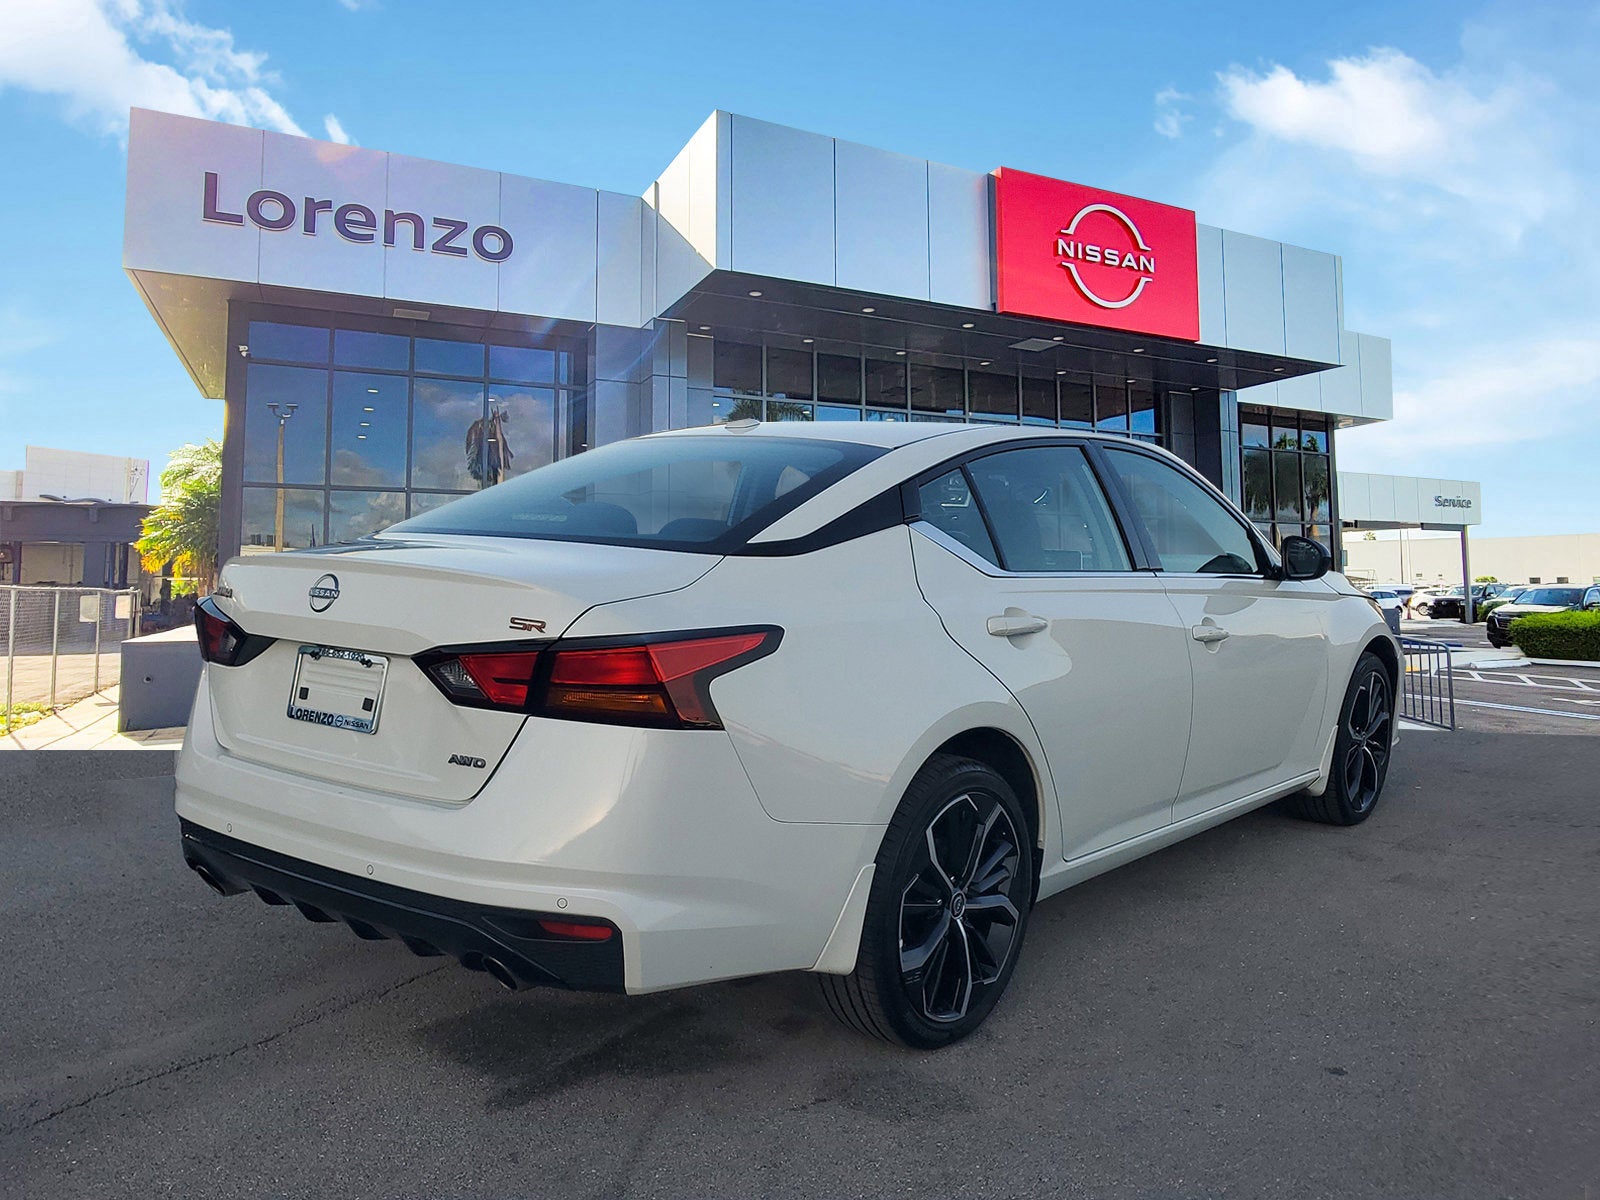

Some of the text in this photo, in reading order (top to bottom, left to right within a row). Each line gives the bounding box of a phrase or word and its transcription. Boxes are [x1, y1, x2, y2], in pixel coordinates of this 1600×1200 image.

[202, 171, 514, 263] Lorenzo
[1057, 238, 1155, 273] NISSAN
[1435, 495, 1472, 508] Service
[509, 617, 546, 633] SR
[290, 706, 370, 730] LORENZO NISSAN
[448, 753, 487, 769] AWD
